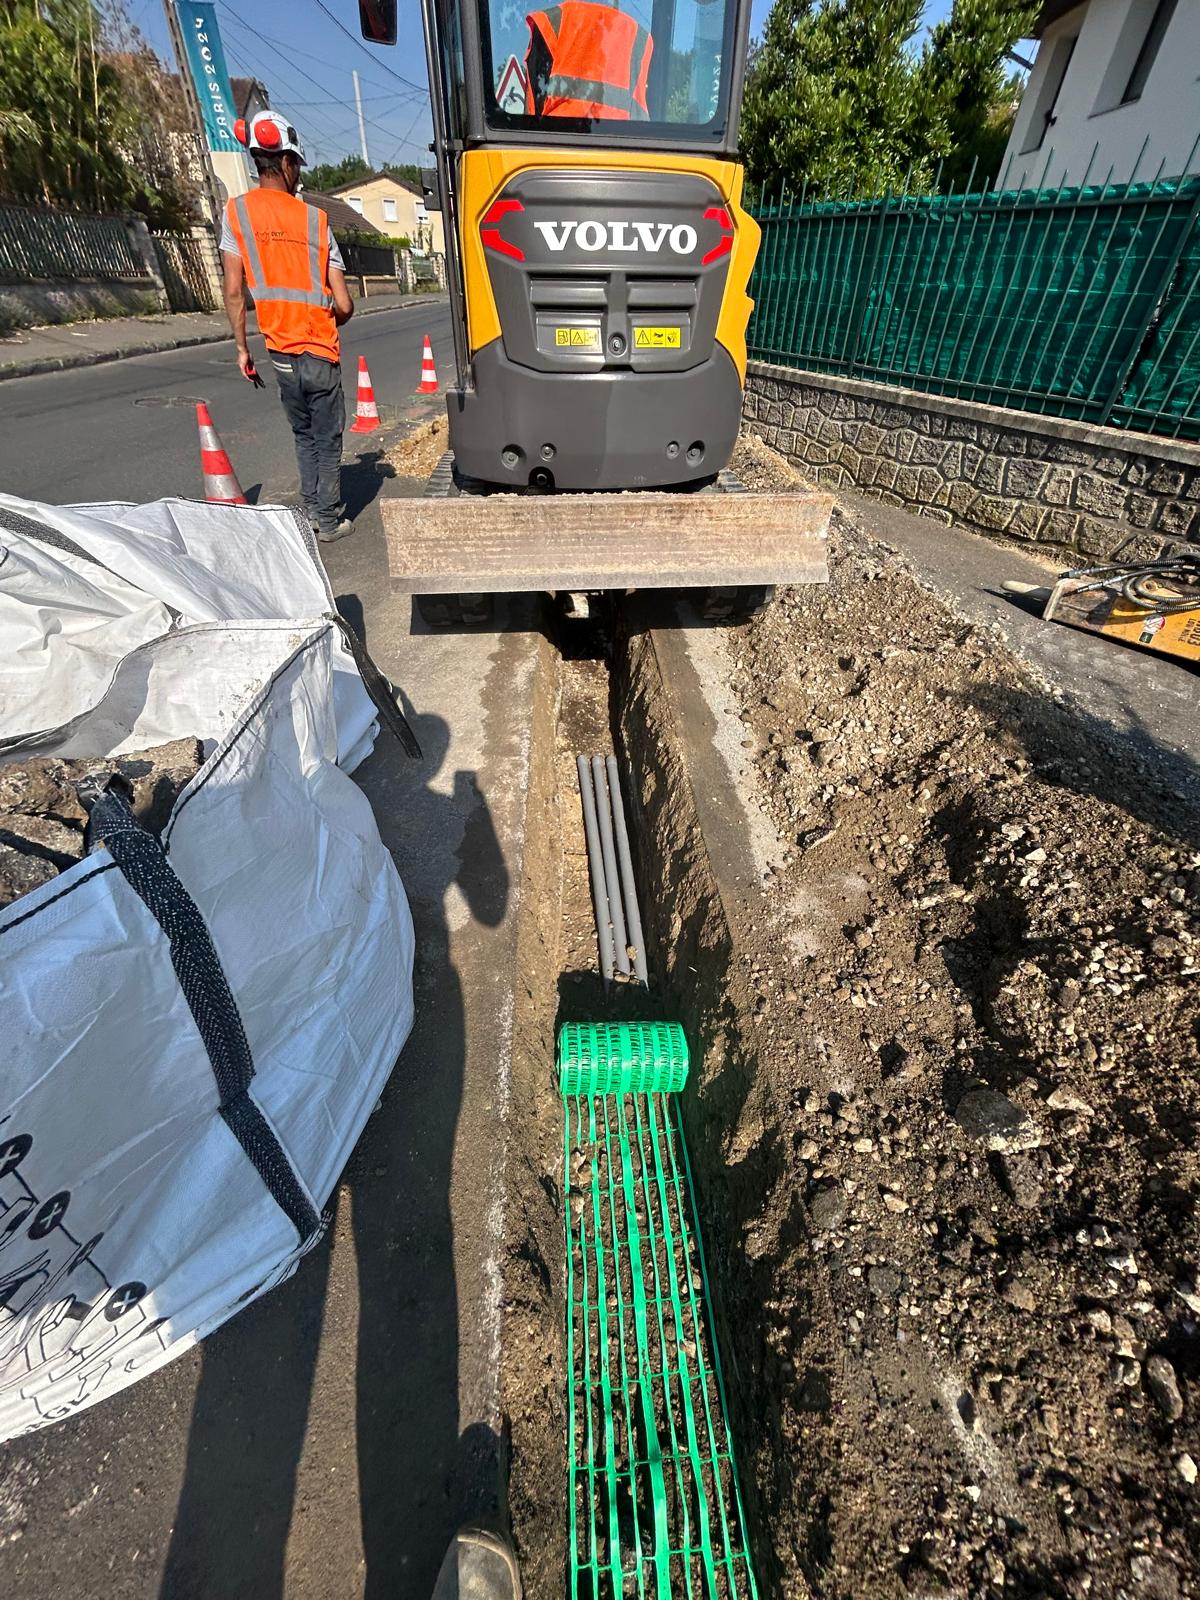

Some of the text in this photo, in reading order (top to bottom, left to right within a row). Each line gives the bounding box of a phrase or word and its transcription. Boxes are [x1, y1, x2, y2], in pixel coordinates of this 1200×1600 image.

[194, 17, 231, 140] PARIS 2024
[533, 220, 698, 255] VOLVO
